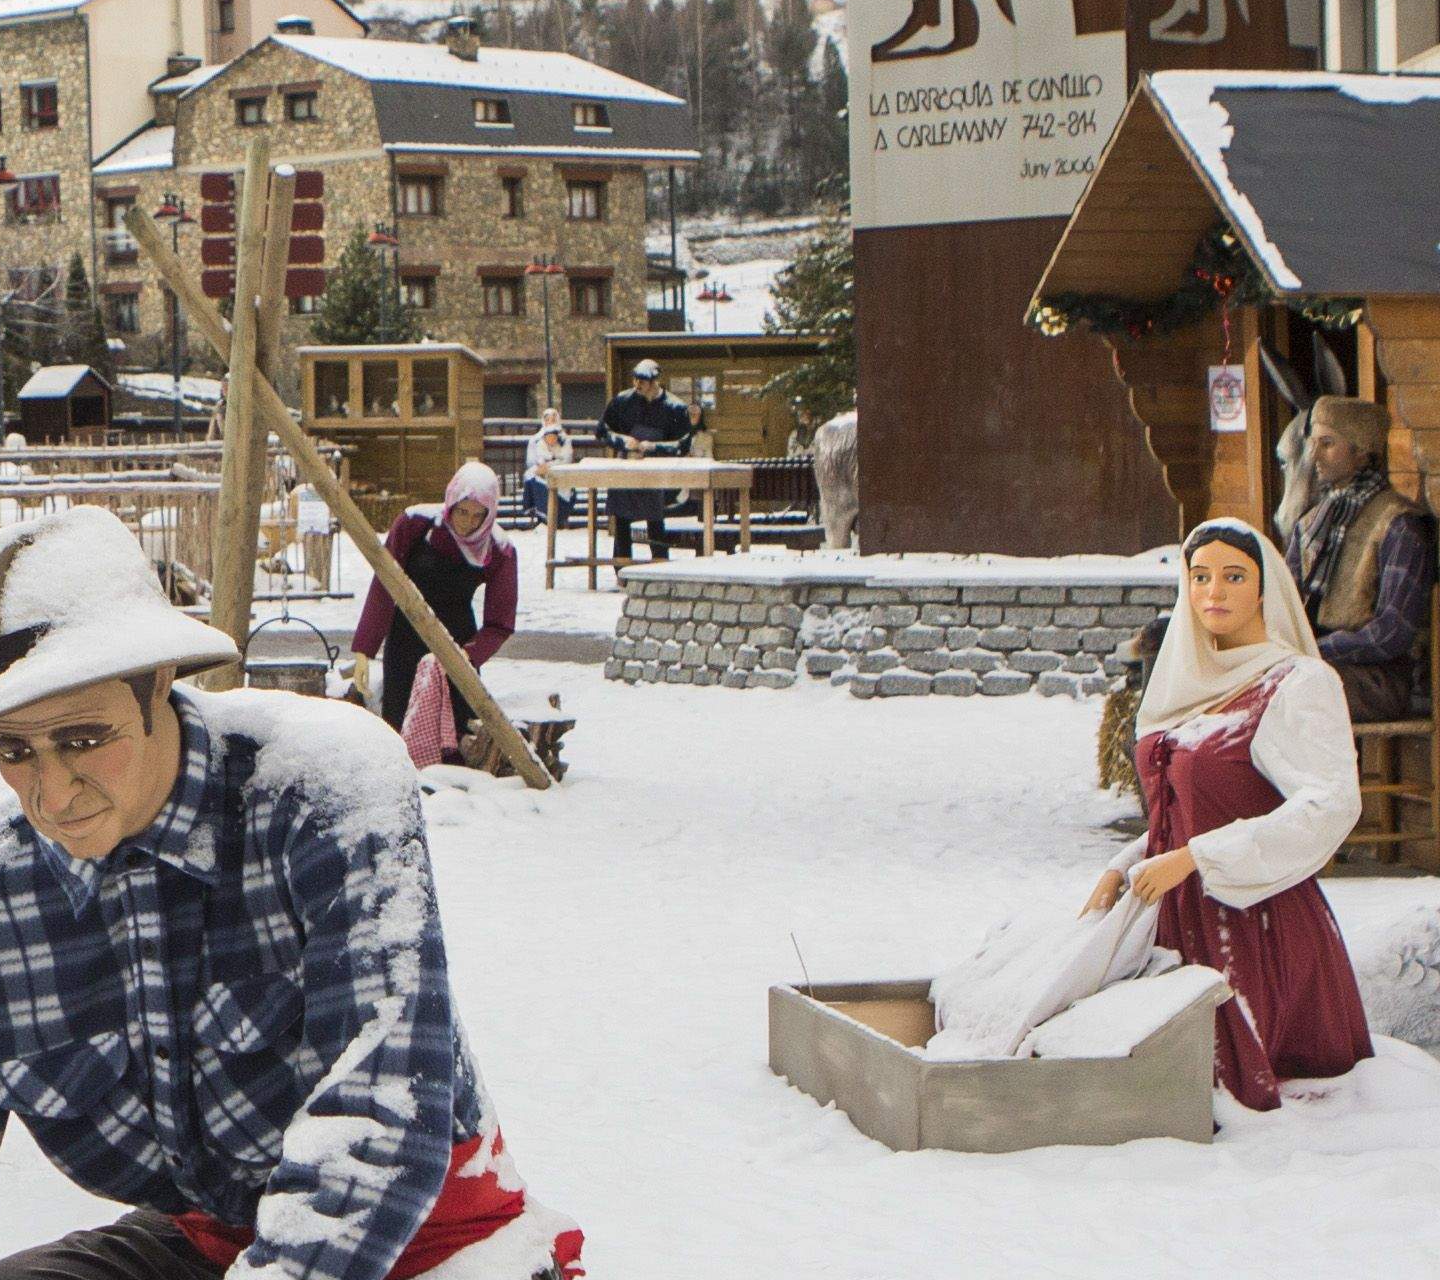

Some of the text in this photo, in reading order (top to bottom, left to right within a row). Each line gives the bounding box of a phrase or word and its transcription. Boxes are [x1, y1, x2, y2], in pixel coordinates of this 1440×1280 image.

[870, 93, 890, 116] LA
[1002, 80, 1022, 103] DE
[1028, 72, 1103, 101] CANILLO
[874, 109, 1097, 150] A CARLEMANY 742-814
